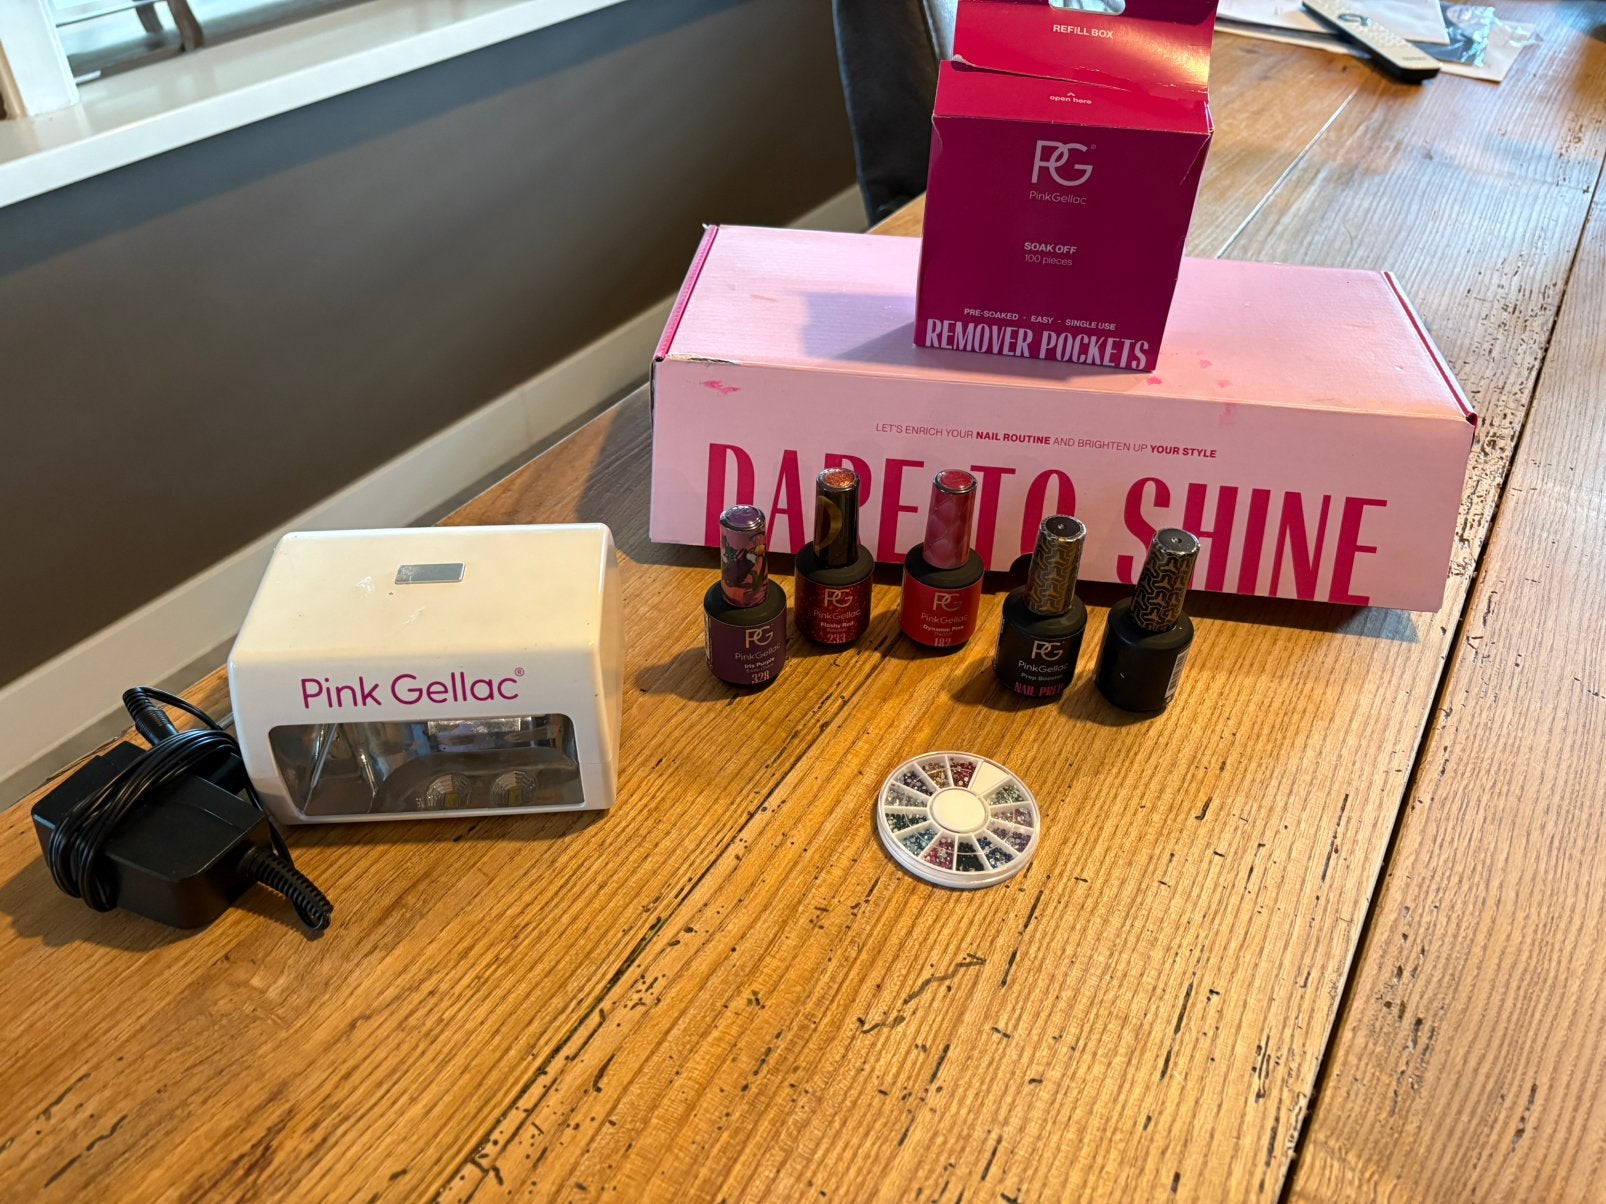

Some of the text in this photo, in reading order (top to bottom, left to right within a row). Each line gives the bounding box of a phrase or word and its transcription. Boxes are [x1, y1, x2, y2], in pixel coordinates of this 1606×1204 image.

[1053, 24, 1113, 39] REFILL BOX
[1050, 95, 1092, 105] open here
[1029, 190, 1087, 205] PinkGellac
[1024, 242, 1077, 255] SOAK OFF
[1025, 254, 1073, 266] 100 pieces
[964, 308, 1116, 330] PRE-SOAKED EASY SINGLE USE
[925, 318, 1149, 370] REMOVER POCKETS
[875, 423, 1217, 458] LET'S ENRICH YOUR NAIL ROUTINE AND BRIGHTEN UP YOUR STYLE
[969, 464, 1076, 572] TO
[1116, 477, 1387, 606] SHINE
[827, 633, 846, 644] 233
[751, 670, 770, 684] 328
[300, 675, 383, 709] Pink
[1014, 681, 1035, 697] NAIL
